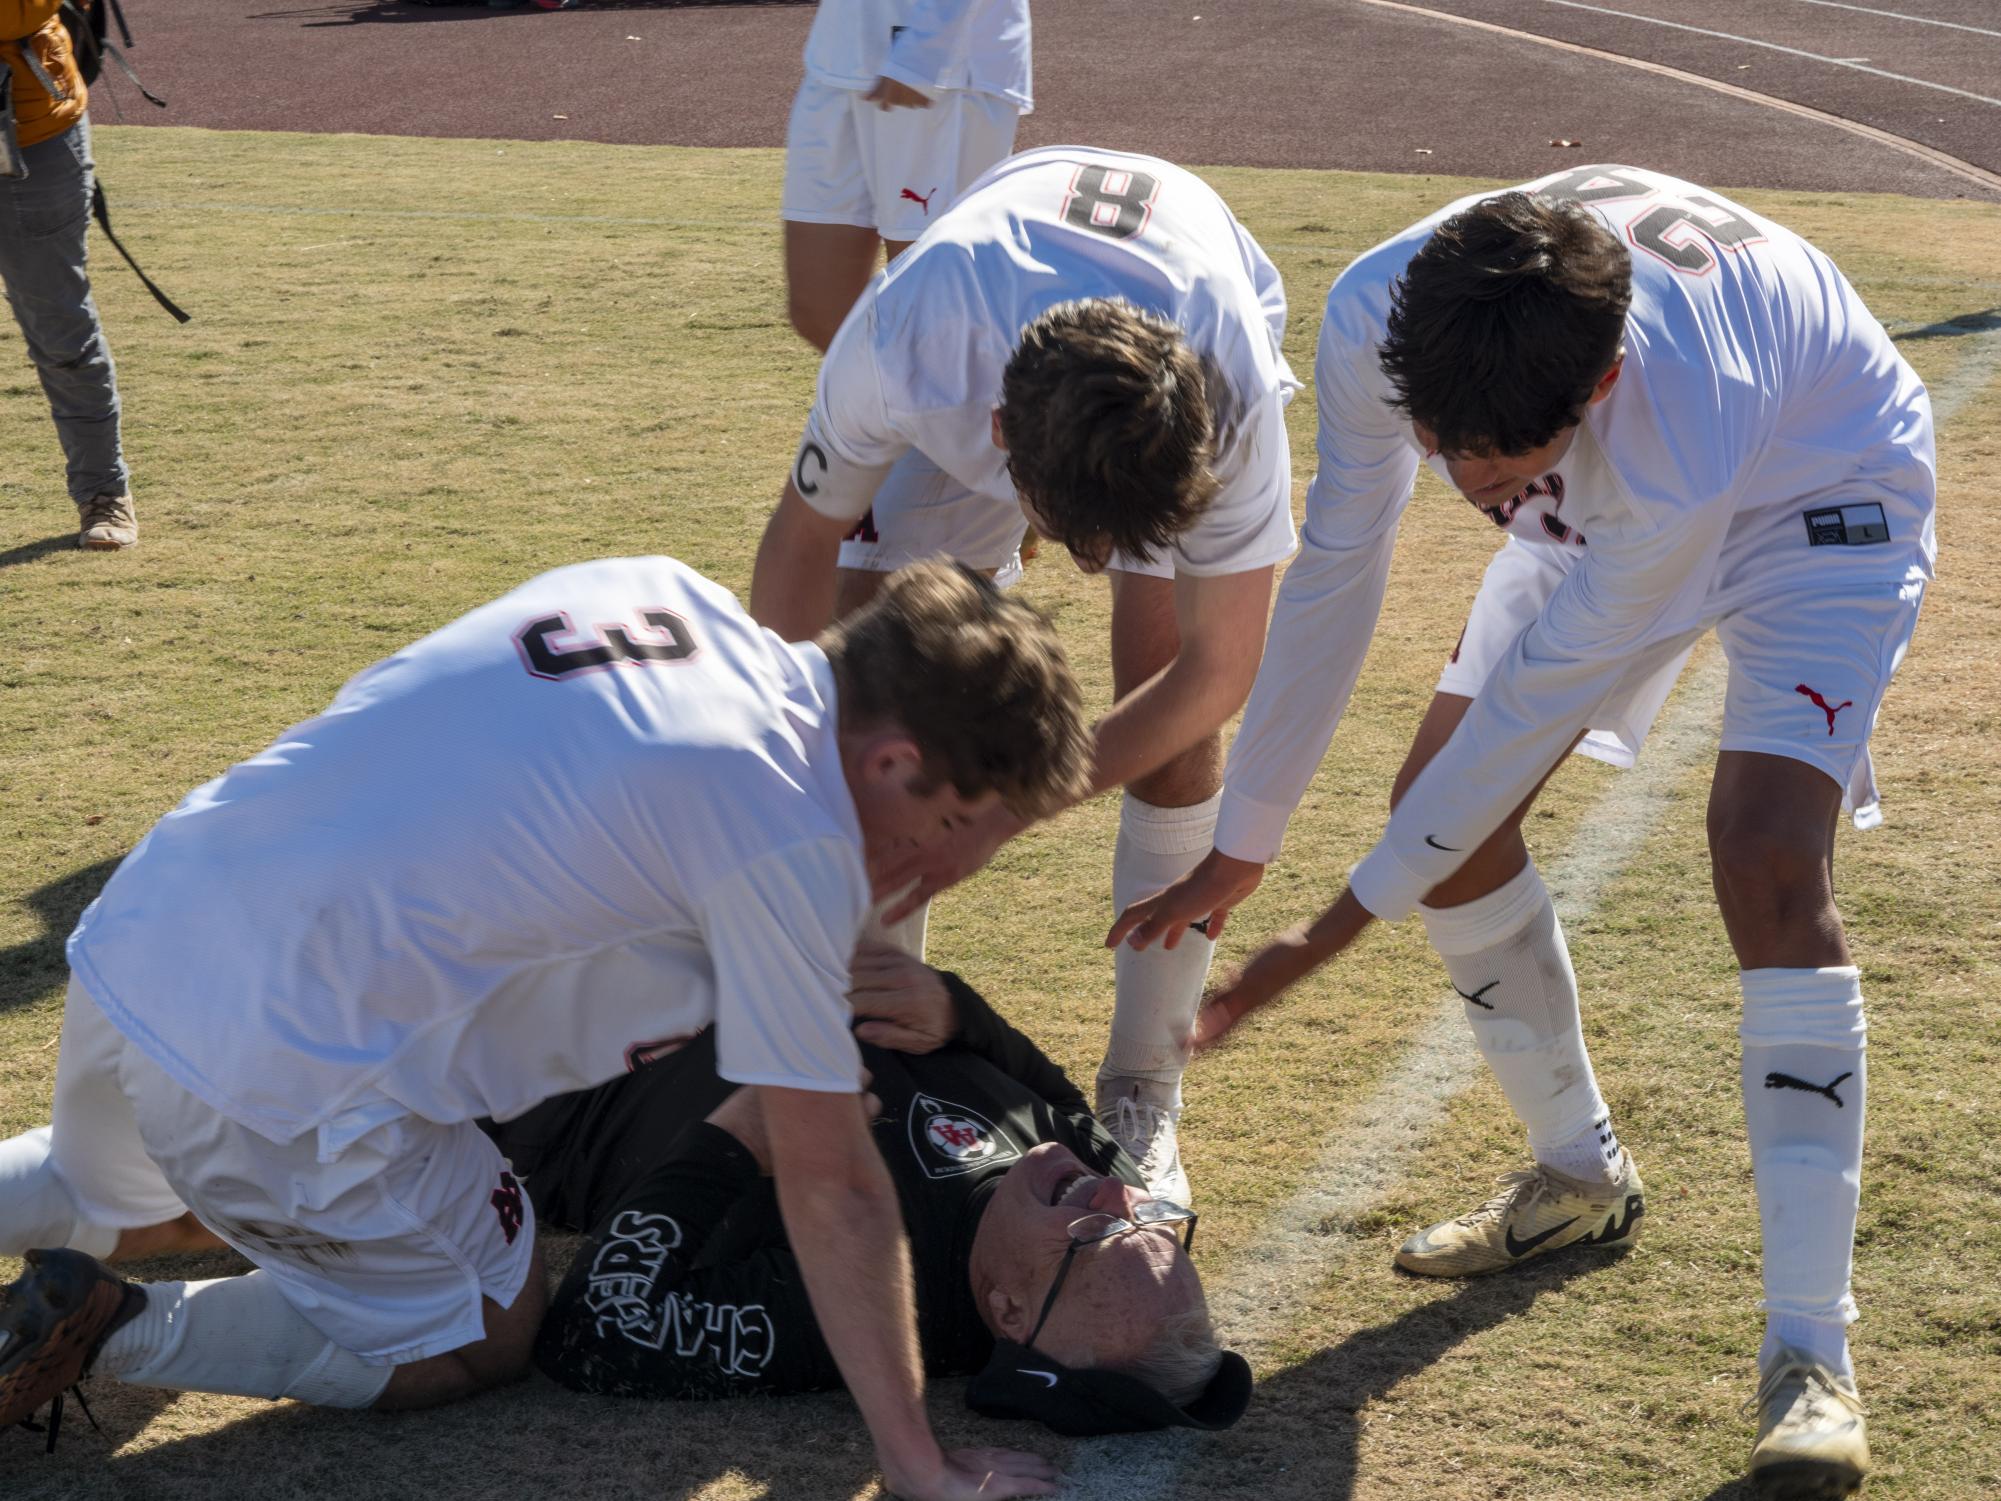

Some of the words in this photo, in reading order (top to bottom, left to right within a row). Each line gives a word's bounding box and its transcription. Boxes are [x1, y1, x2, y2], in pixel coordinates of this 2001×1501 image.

[1059, 163, 1161, 241] 8
[797, 443, 828, 498] C
[1863, 526, 1874, 538] L
[510, 606, 703, 682] 3
